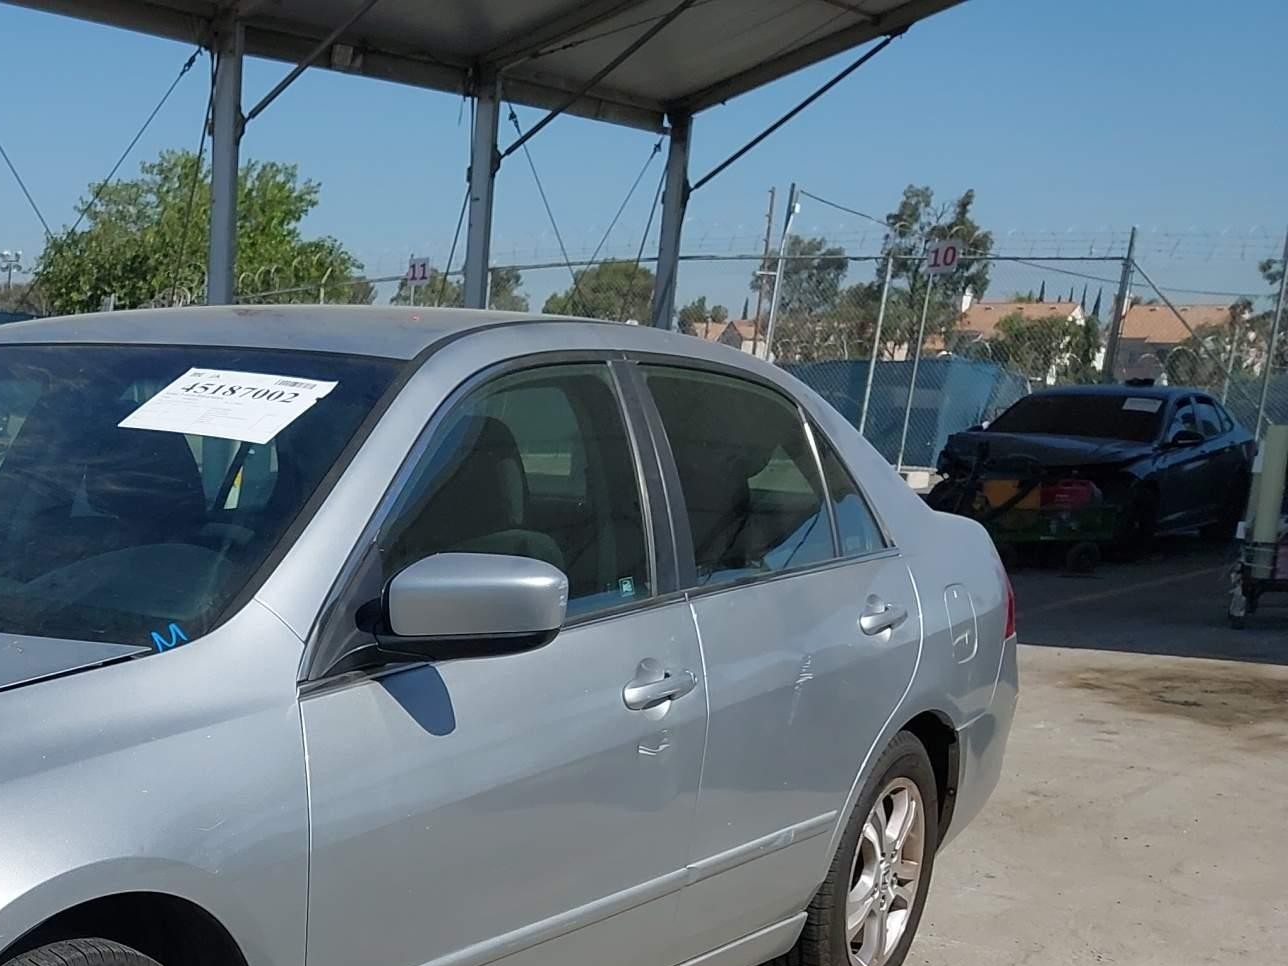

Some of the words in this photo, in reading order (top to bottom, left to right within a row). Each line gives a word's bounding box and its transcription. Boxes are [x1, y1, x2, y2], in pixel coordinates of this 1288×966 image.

[928, 245, 957, 268] 10
[409, 262, 428, 281] 11
[181, 382, 300, 403] 45187002
[150, 622, 189, 653] M
